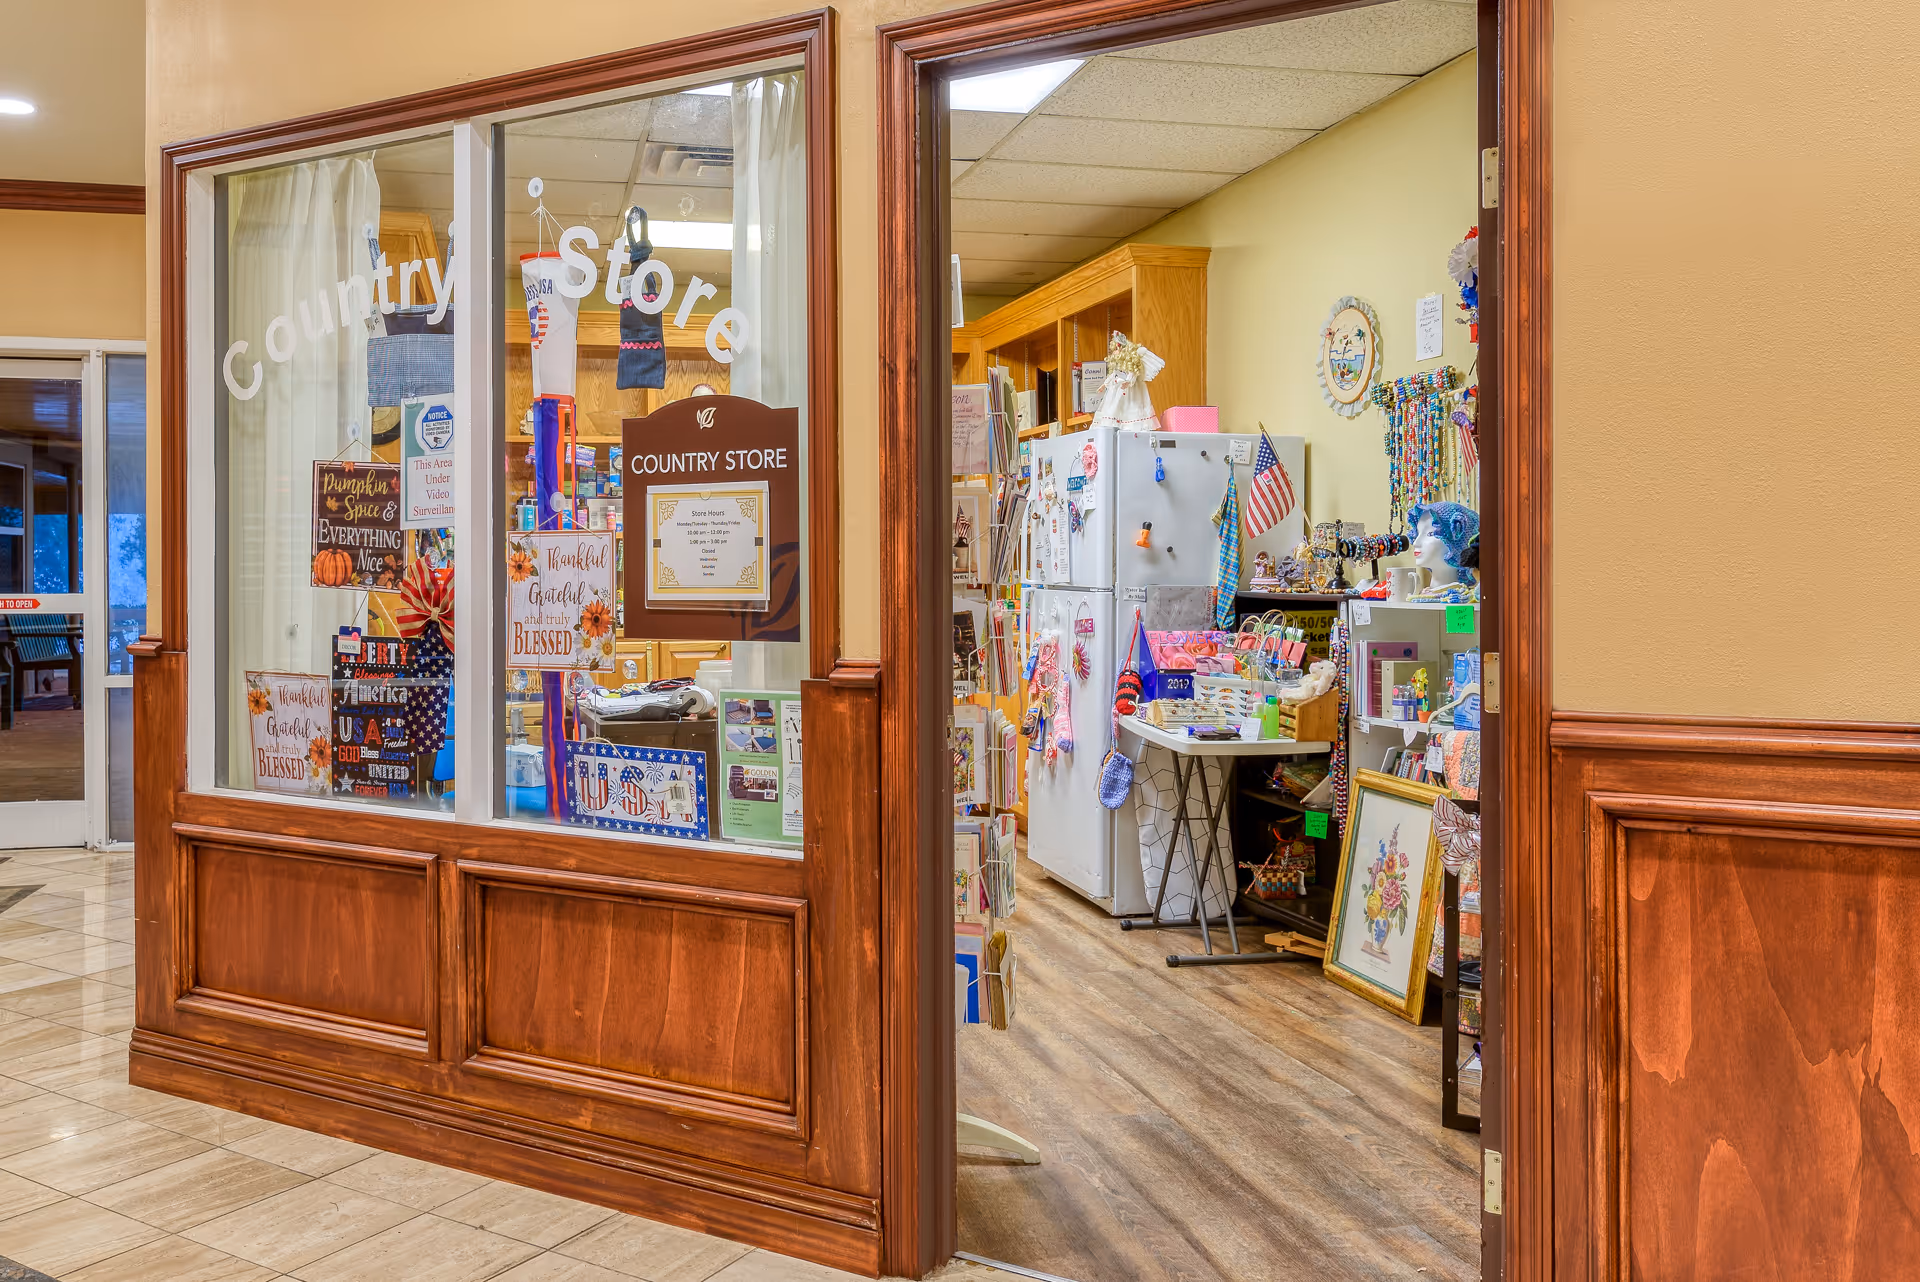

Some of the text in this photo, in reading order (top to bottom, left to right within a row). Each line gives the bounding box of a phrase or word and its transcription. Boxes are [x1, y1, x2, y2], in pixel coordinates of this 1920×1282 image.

[222, 225, 750, 401] Country Store
[427, 410, 448, 421] NOTICE
[414, 458, 453, 471] This Area
[631, 447, 788, 475] COUNTRY STORE
[323, 470, 389, 499] Pumpkin
[425, 473, 451, 485] Under
[426, 489, 450, 500] Video
[344, 495, 397, 524] Spice &
[413, 505, 454, 517] Surveillan
[707, 509, 725, 517] Hours
[318, 518, 402, 550] EVERYTHING
[356, 548, 384, 572] Nice
[546, 541, 609, 572] Thankful
[5, 600, 15, 608] TO
[15, 600, 33, 608] OPEN
[528, 581, 586, 609] Grateful
[524, 612, 571, 628] and truly
[513, 622, 573, 656] BLESSED
[1149, 631, 1224, 645] FLOWERS
[354, 668, 396, 687] Blessings
[277, 682, 327, 709] Thankful
[339, 679, 408, 705] America
[266, 716, 311, 740] Grateful
[338, 716, 382, 745] USA
[265, 742, 301, 757] and truly
[383, 738, 408, 749] Freedom
[338, 745, 410, 763] GOD Bless America
[258, 747, 305, 781] BLESSED
[367, 763, 410, 780] UNITED
[750, 768, 777, 778] GOLDEN
[354, 782, 409, 798] FOREVER USA
